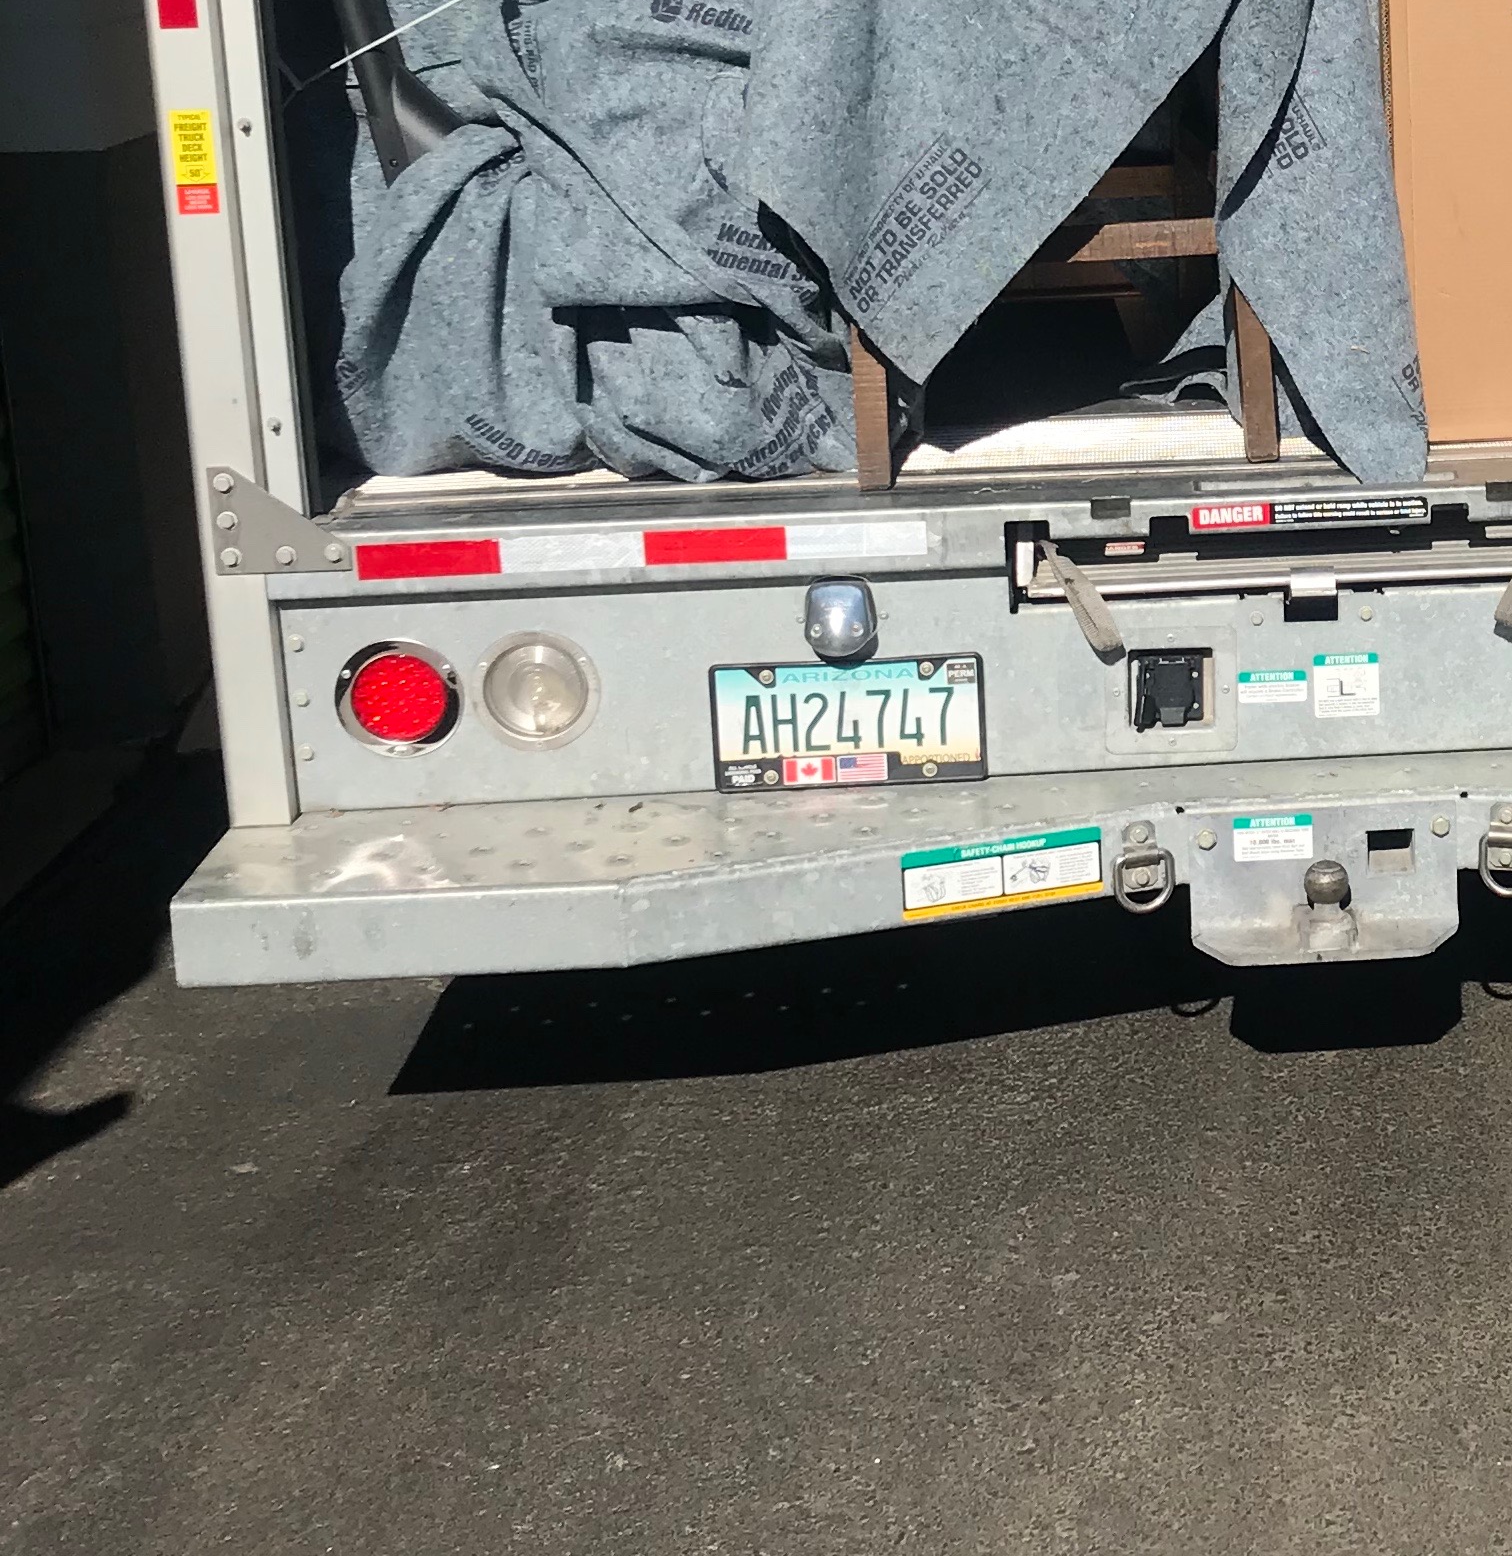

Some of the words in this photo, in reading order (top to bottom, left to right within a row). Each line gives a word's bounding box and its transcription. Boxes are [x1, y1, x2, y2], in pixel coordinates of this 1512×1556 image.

[1281, 117, 1309, 160] OLD
[850, 256, 877, 300] NOT
[874, 228, 897, 256] TO
[894, 200, 923, 229] BE
[920, 148, 968, 200] SOLD
[857, 285, 879, 313] OR
[875, 159, 983, 285] TRANSFERRED
[1200, 506, 1264, 525] DANGER
[1324, 654, 1369, 665] ATTENTION
[782, 668, 914, 684] ARIZONA
[1250, 672, 1294, 682] ATTENTION
[743, 687, 954, 754] AH24747
[1249, 817, 1296, 828] ATTENTION
[961, 842, 1015, 858] SAFETY-CHAIN
[1016, 838, 1047, 851] HOOKUP
